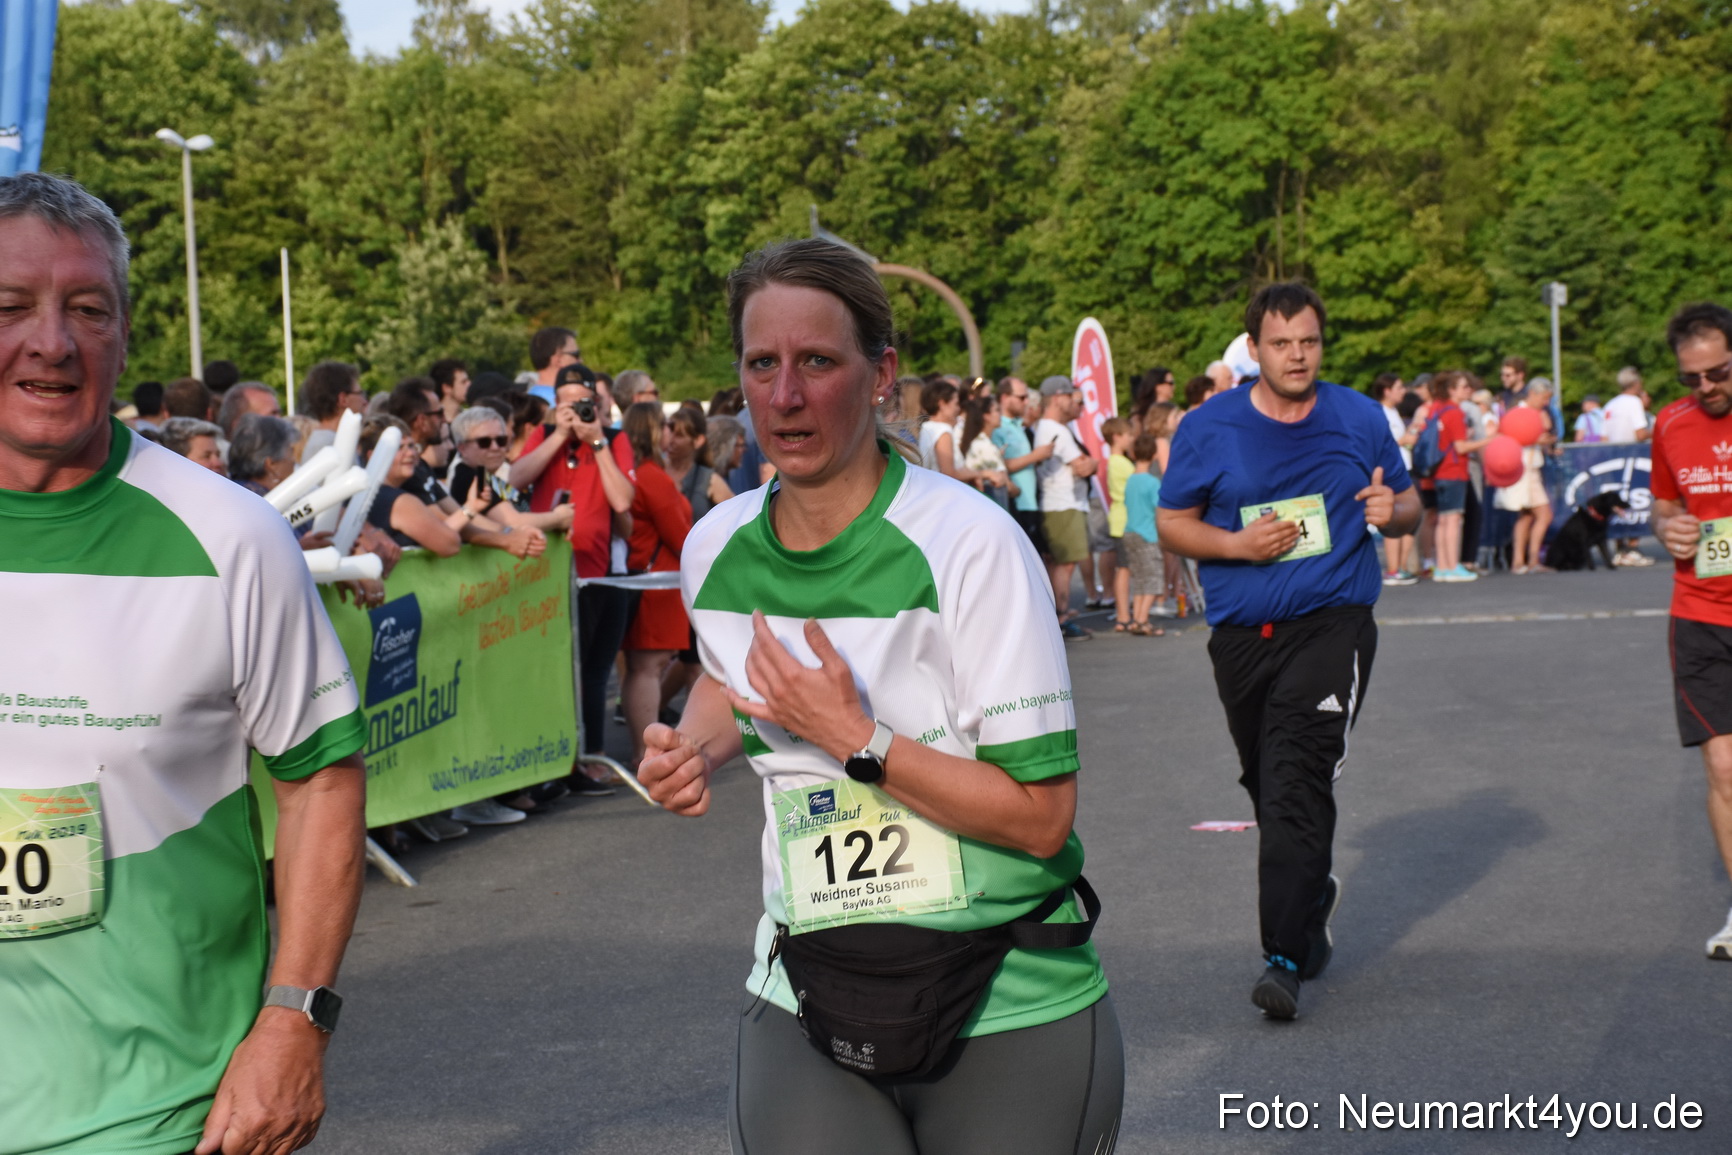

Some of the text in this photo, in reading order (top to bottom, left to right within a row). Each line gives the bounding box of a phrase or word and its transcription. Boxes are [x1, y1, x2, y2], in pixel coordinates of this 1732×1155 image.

[17, 693, 88, 709] Baustoffe
[365, 659, 462, 754] menlauf
[12, 710, 34, 723] ein
[39, 713, 79, 727] gutes
[84, 713, 162, 731] Baugefühl
[366, 750, 398, 778] markt
[800, 804, 862, 829] firmenlauf
[879, 810, 901, 822] run
[49, 823, 88, 839] 2019
[814, 824, 915, 886] 122
[810, 877, 929, 904] Weidner Susanne
[18, 896, 65, 911] Mario
[842, 895, 892, 911] BayWa AG
